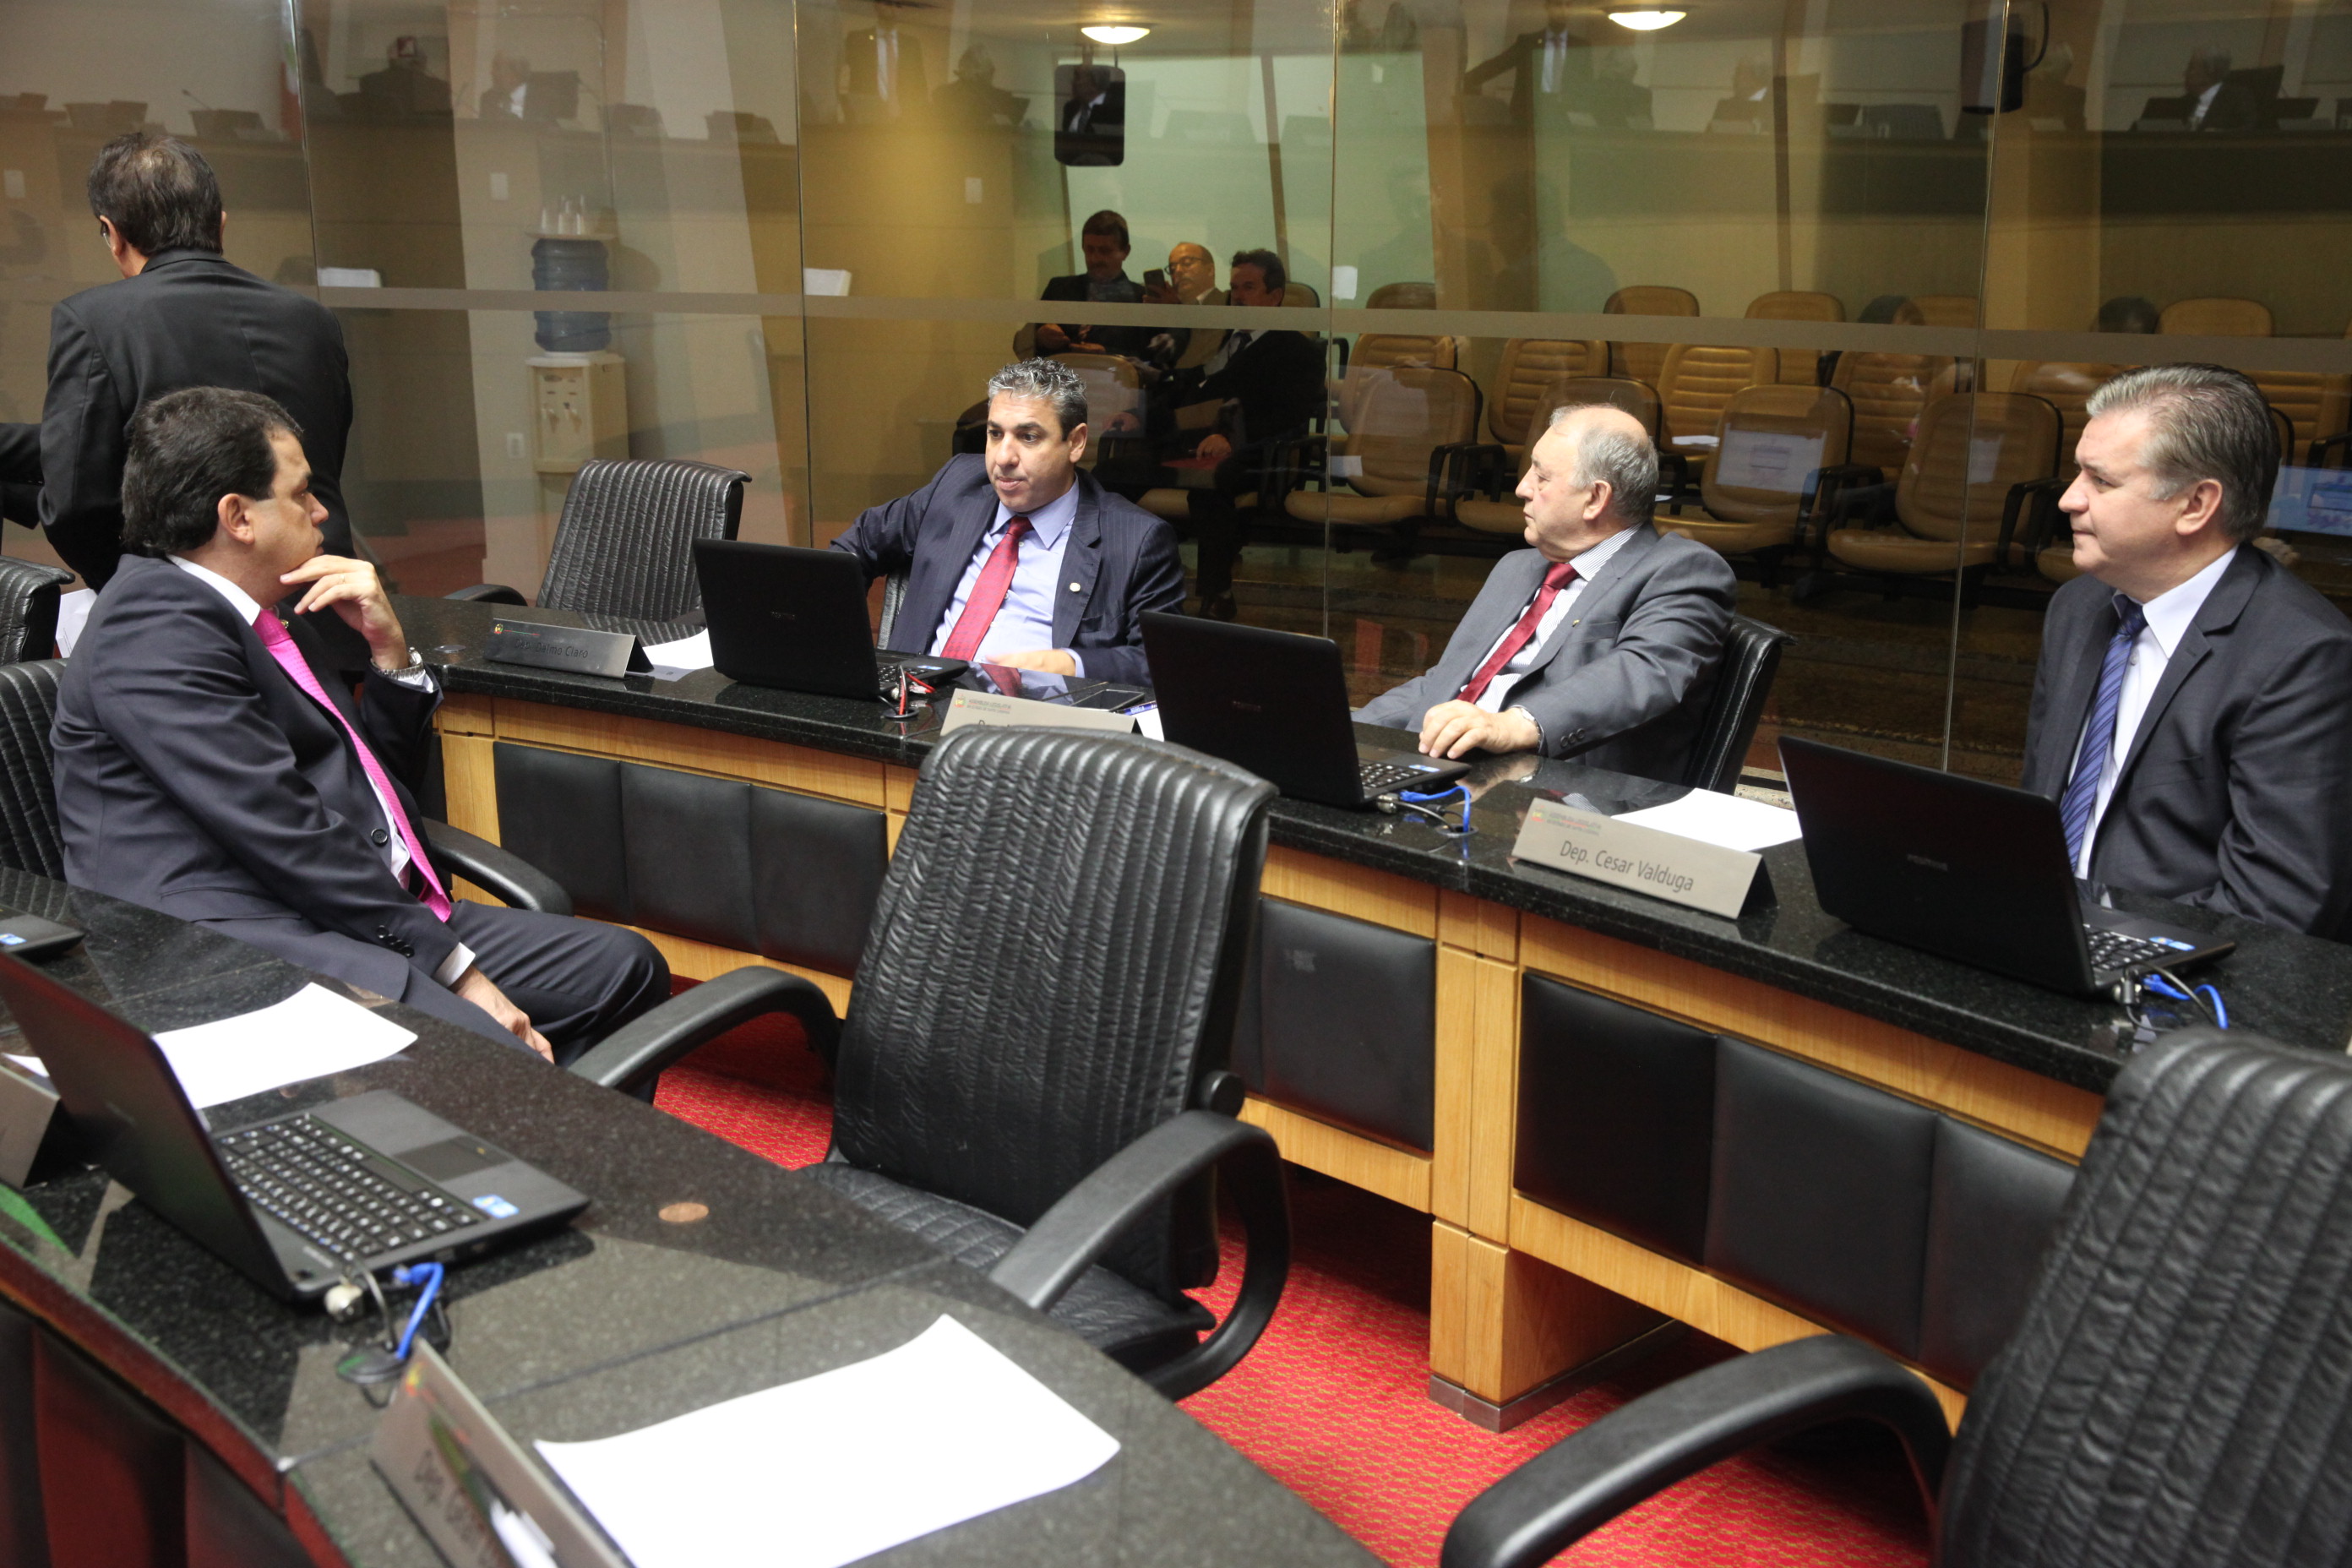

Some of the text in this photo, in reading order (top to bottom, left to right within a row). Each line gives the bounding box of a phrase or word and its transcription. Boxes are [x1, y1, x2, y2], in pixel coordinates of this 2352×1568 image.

[565, 645, 589, 659] Claro
[1560, 840, 1694, 893] Dep. Cesar Valduga
